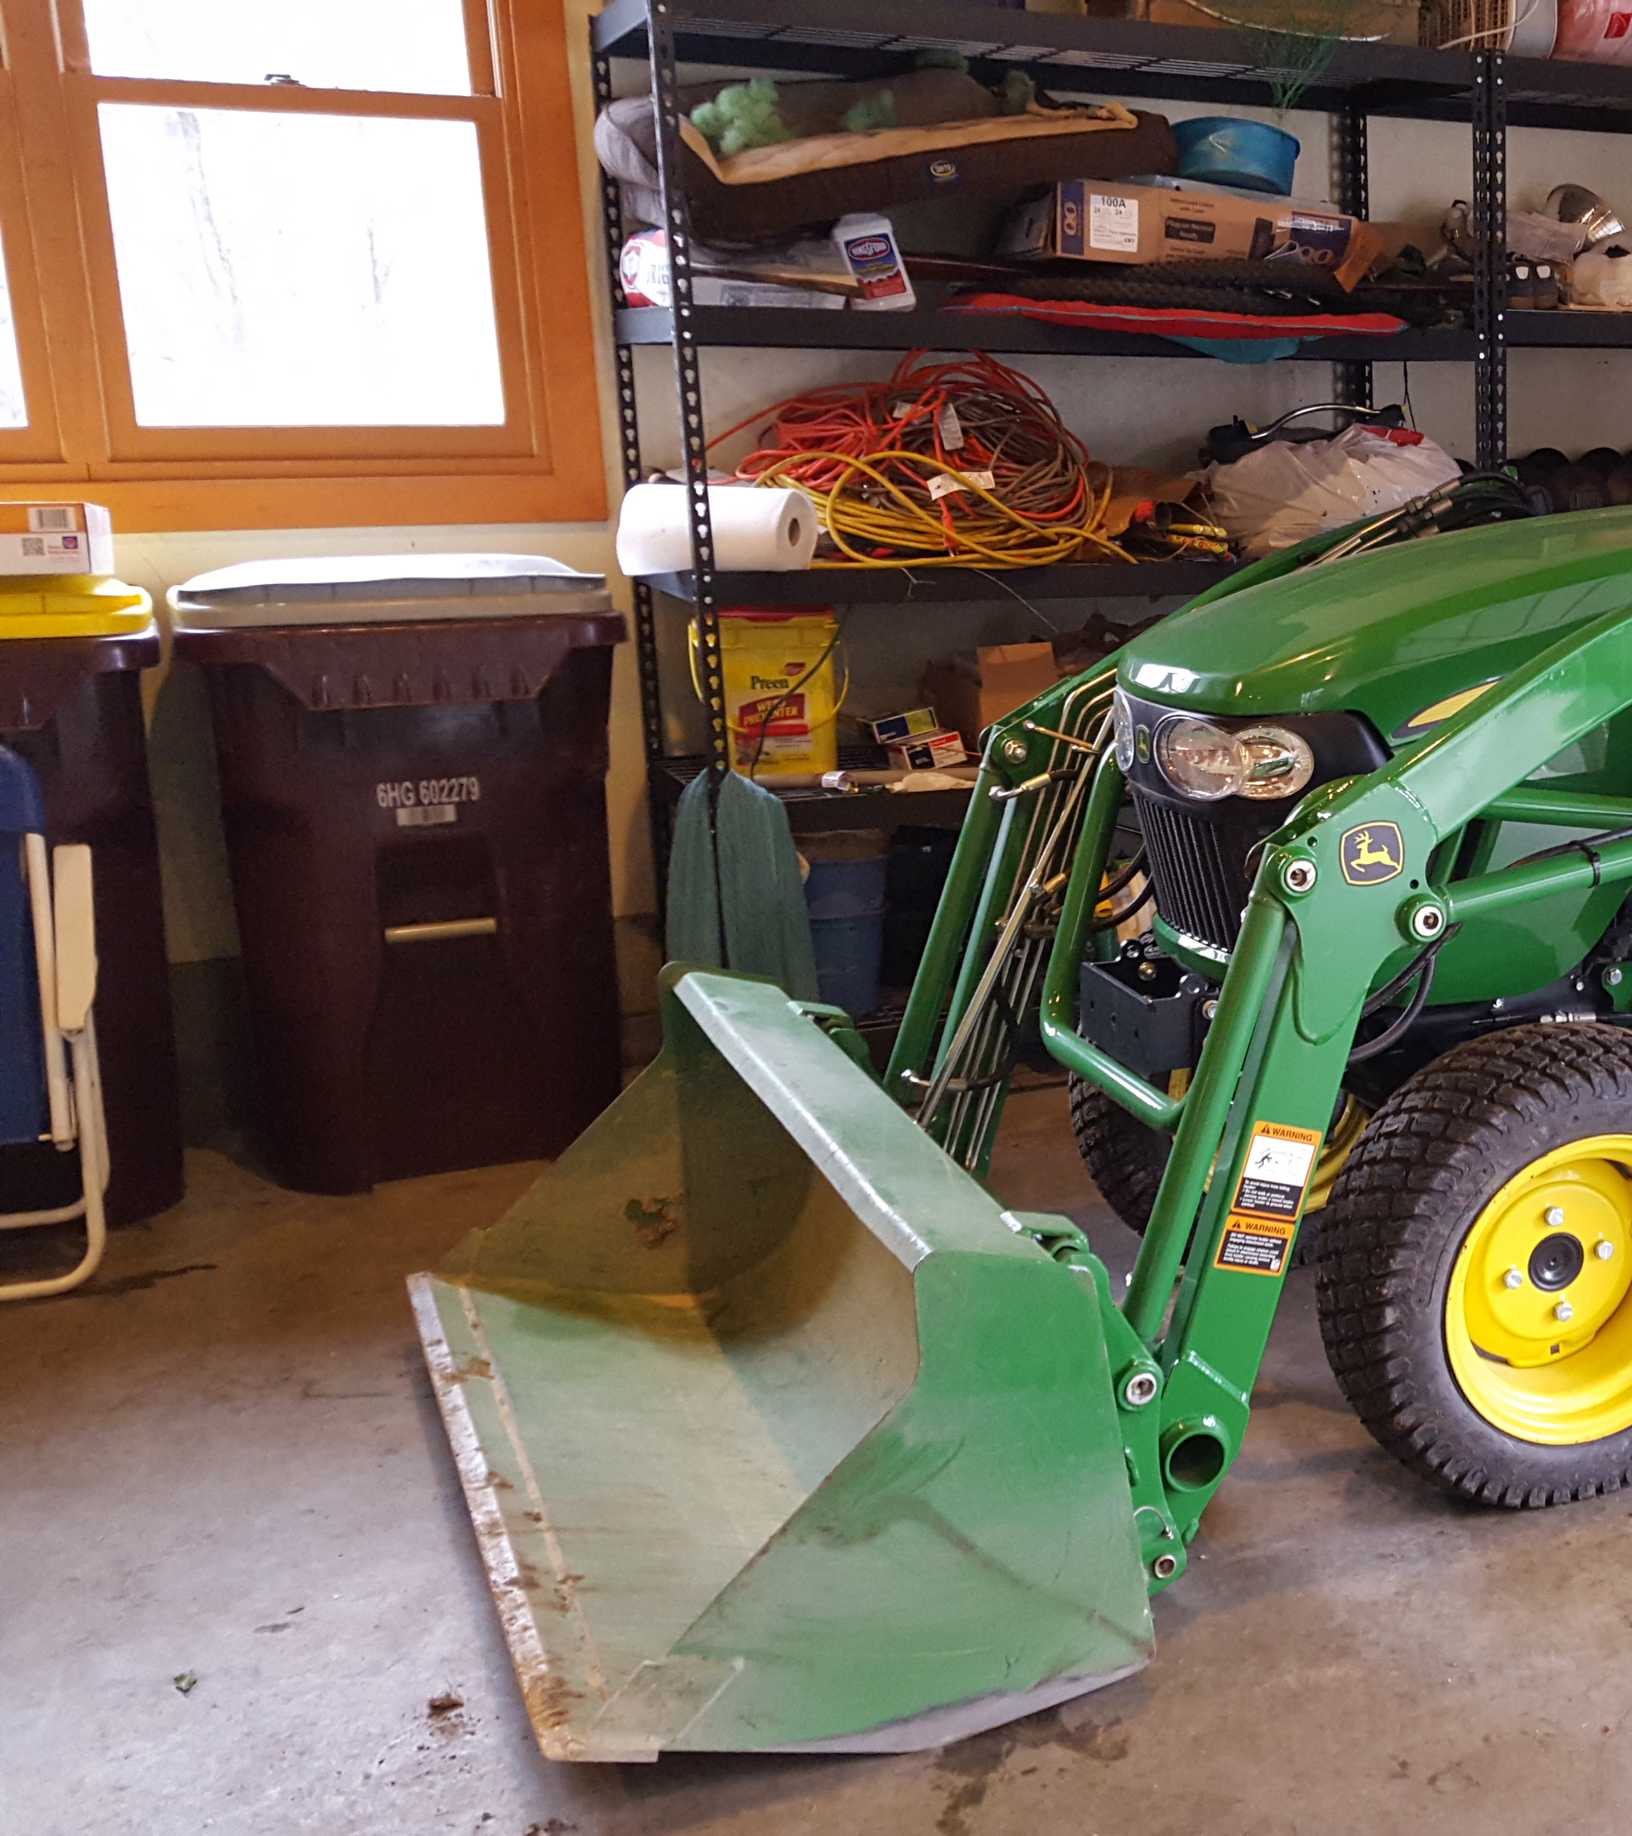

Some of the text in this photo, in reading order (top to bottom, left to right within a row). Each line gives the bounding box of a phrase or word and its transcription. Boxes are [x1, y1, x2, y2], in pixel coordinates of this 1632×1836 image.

[1101, 197, 1126, 208] 100A
[750, 675, 790, 690] Preen
[376, 776, 481, 808] 6HG 602279
[1272, 1127, 1313, 1142] WARNING
[1245, 1221, 1286, 1235] WARNING
